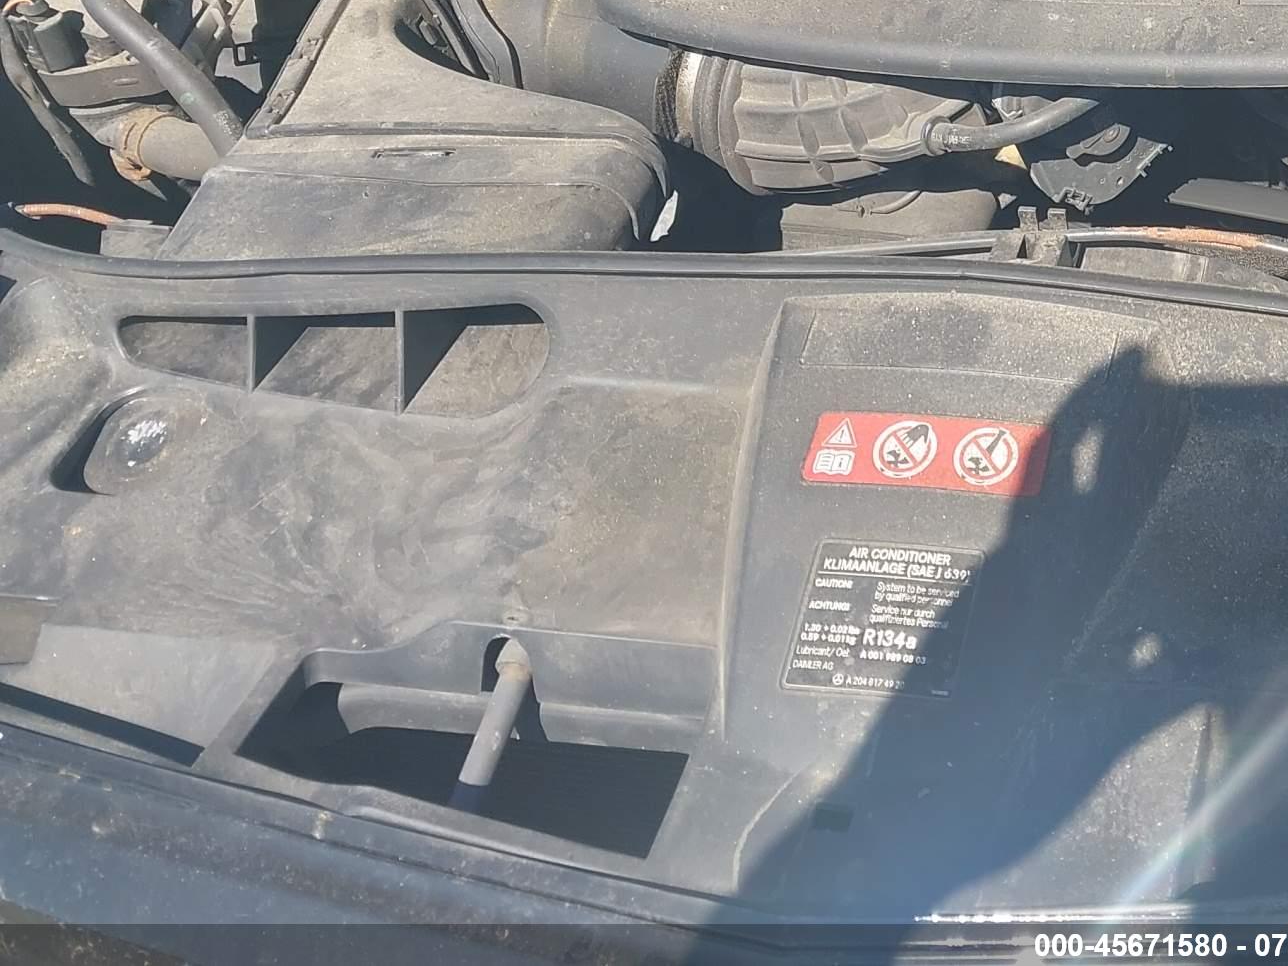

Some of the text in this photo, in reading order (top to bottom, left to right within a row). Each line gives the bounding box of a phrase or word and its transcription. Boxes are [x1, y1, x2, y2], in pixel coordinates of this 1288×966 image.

[849, 546, 952, 566] AIR CONDITIONER
[823, 557, 906, 575] KLIMAANLAGE
[906, 565, 935, 578] (SAE
[876, 581, 906, 594] System
[906, 584, 916, 594] to
[916, 585, 927, 595] be
[874, 592, 885, 602] by
[871, 603, 936, 619] Service nur durch
[862, 628, 918, 650] R134a
[792, 659, 835, 671] DAIMLER AG
